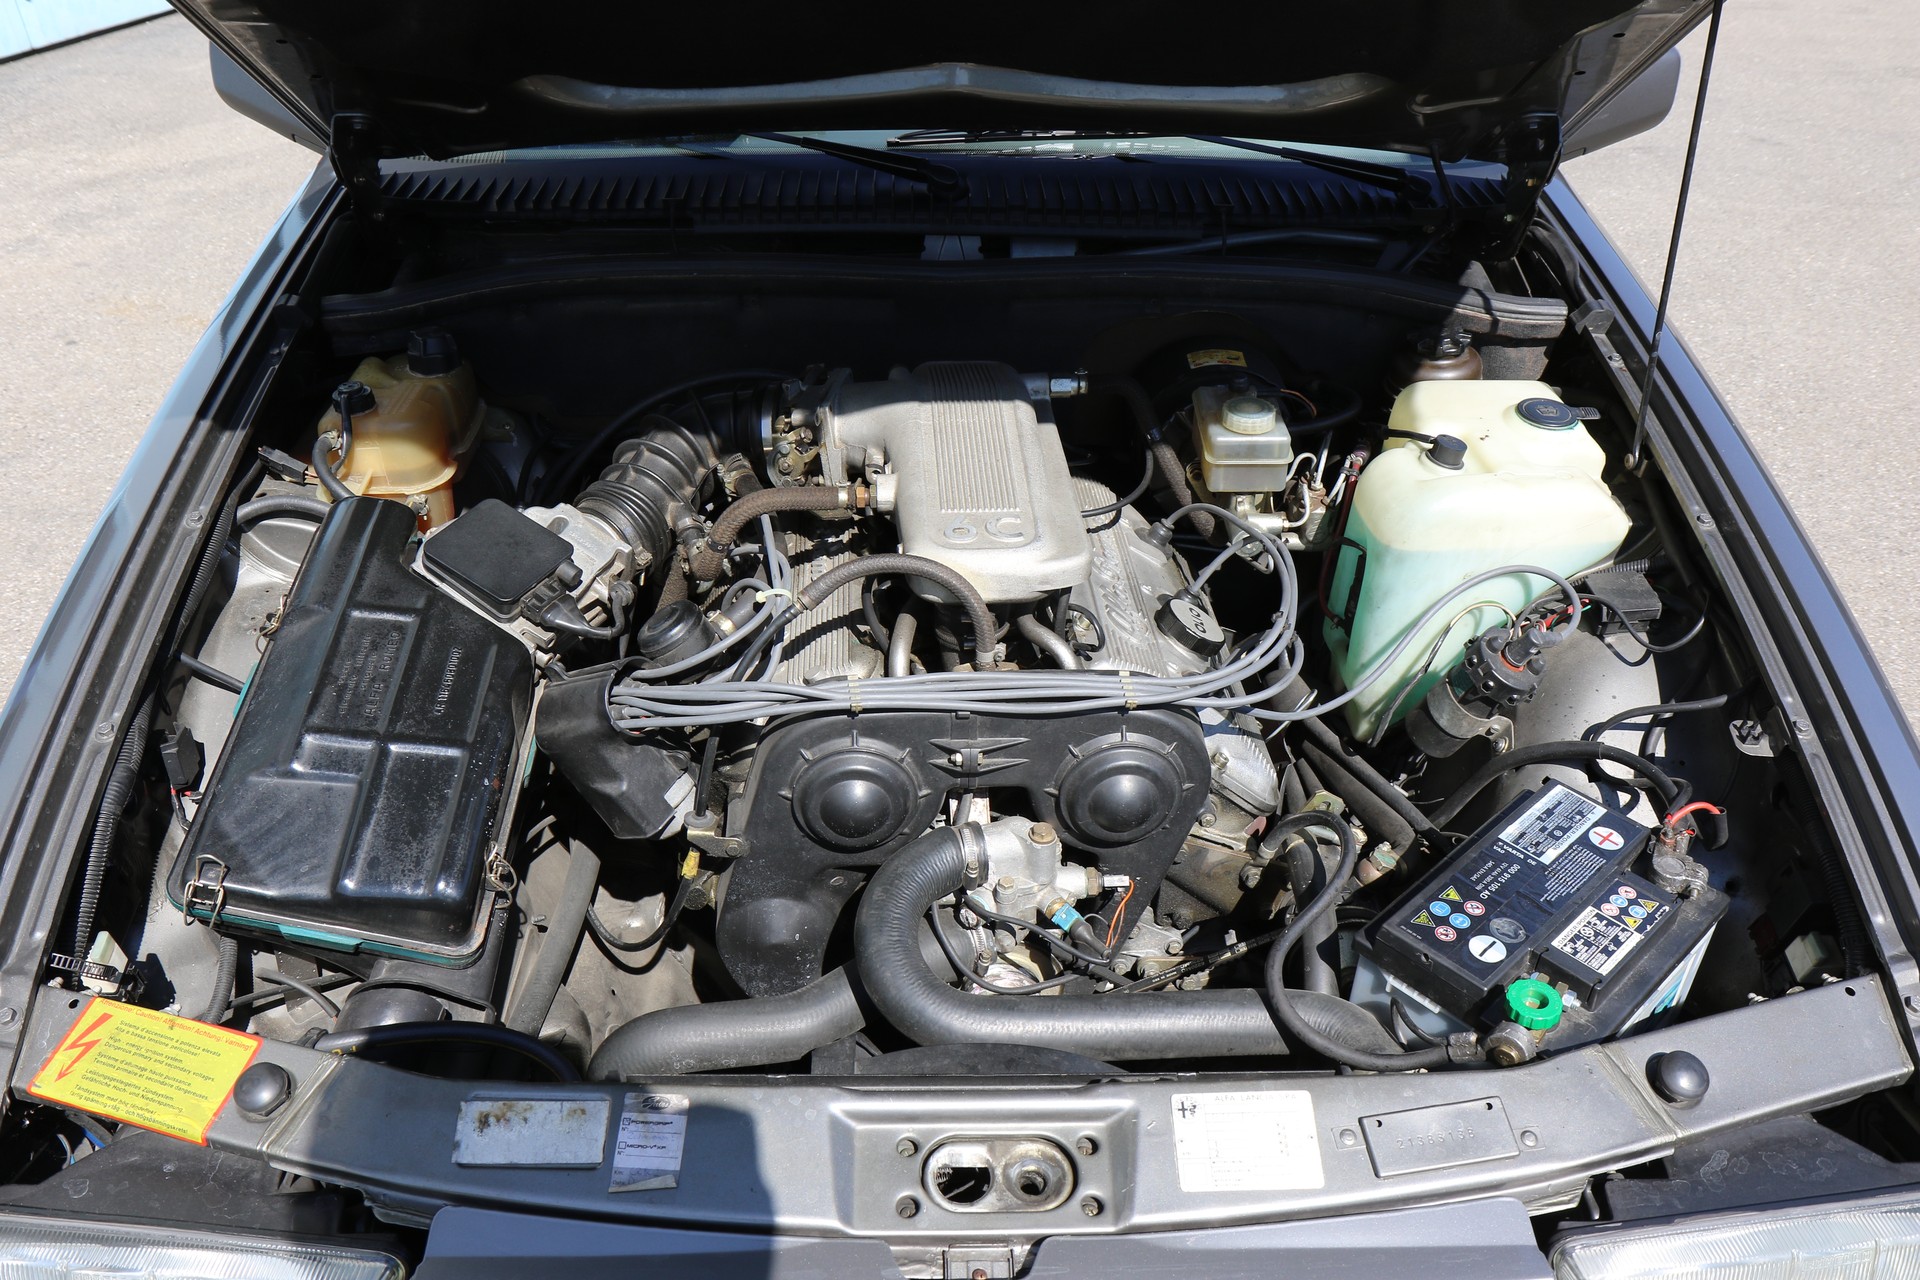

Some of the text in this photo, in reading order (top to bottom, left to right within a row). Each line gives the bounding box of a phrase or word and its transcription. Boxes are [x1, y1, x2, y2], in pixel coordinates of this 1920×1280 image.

[1188, 606, 1206, 634] OLIO
[364, 632, 400, 716] ALFA ROMEO
[1503, 845, 1524, 859] VARTA
[1498, 872, 1511, 883] 915
[1508, 864, 1520, 874] 000
[1480, 890, 1490, 899] AD
[98, 998, 252, 1052] Attenzione! Caution! Attention! Achtung! Varning!
[118, 1020, 139, 1030] Sistema
[179, 1040, 200, 1050] potenza
[201, 1047, 221, 1056] elevata
[125, 1042, 143, 1051] energy
[143, 1047, 164, 1056] ignition
[130, 1031, 146, 1039] bassa
[146, 1036, 169, 1047] tensione
[104, 1041, 132, 1054] Dangerous
[131, 1051, 152, 1061] primary
[164, 1062, 191, 1074] secondary
[92, 1057, 116, 1068] Tensions
[115, 1066, 138, 1076] primaire
[145, 1075, 174, 1088] secondaire
